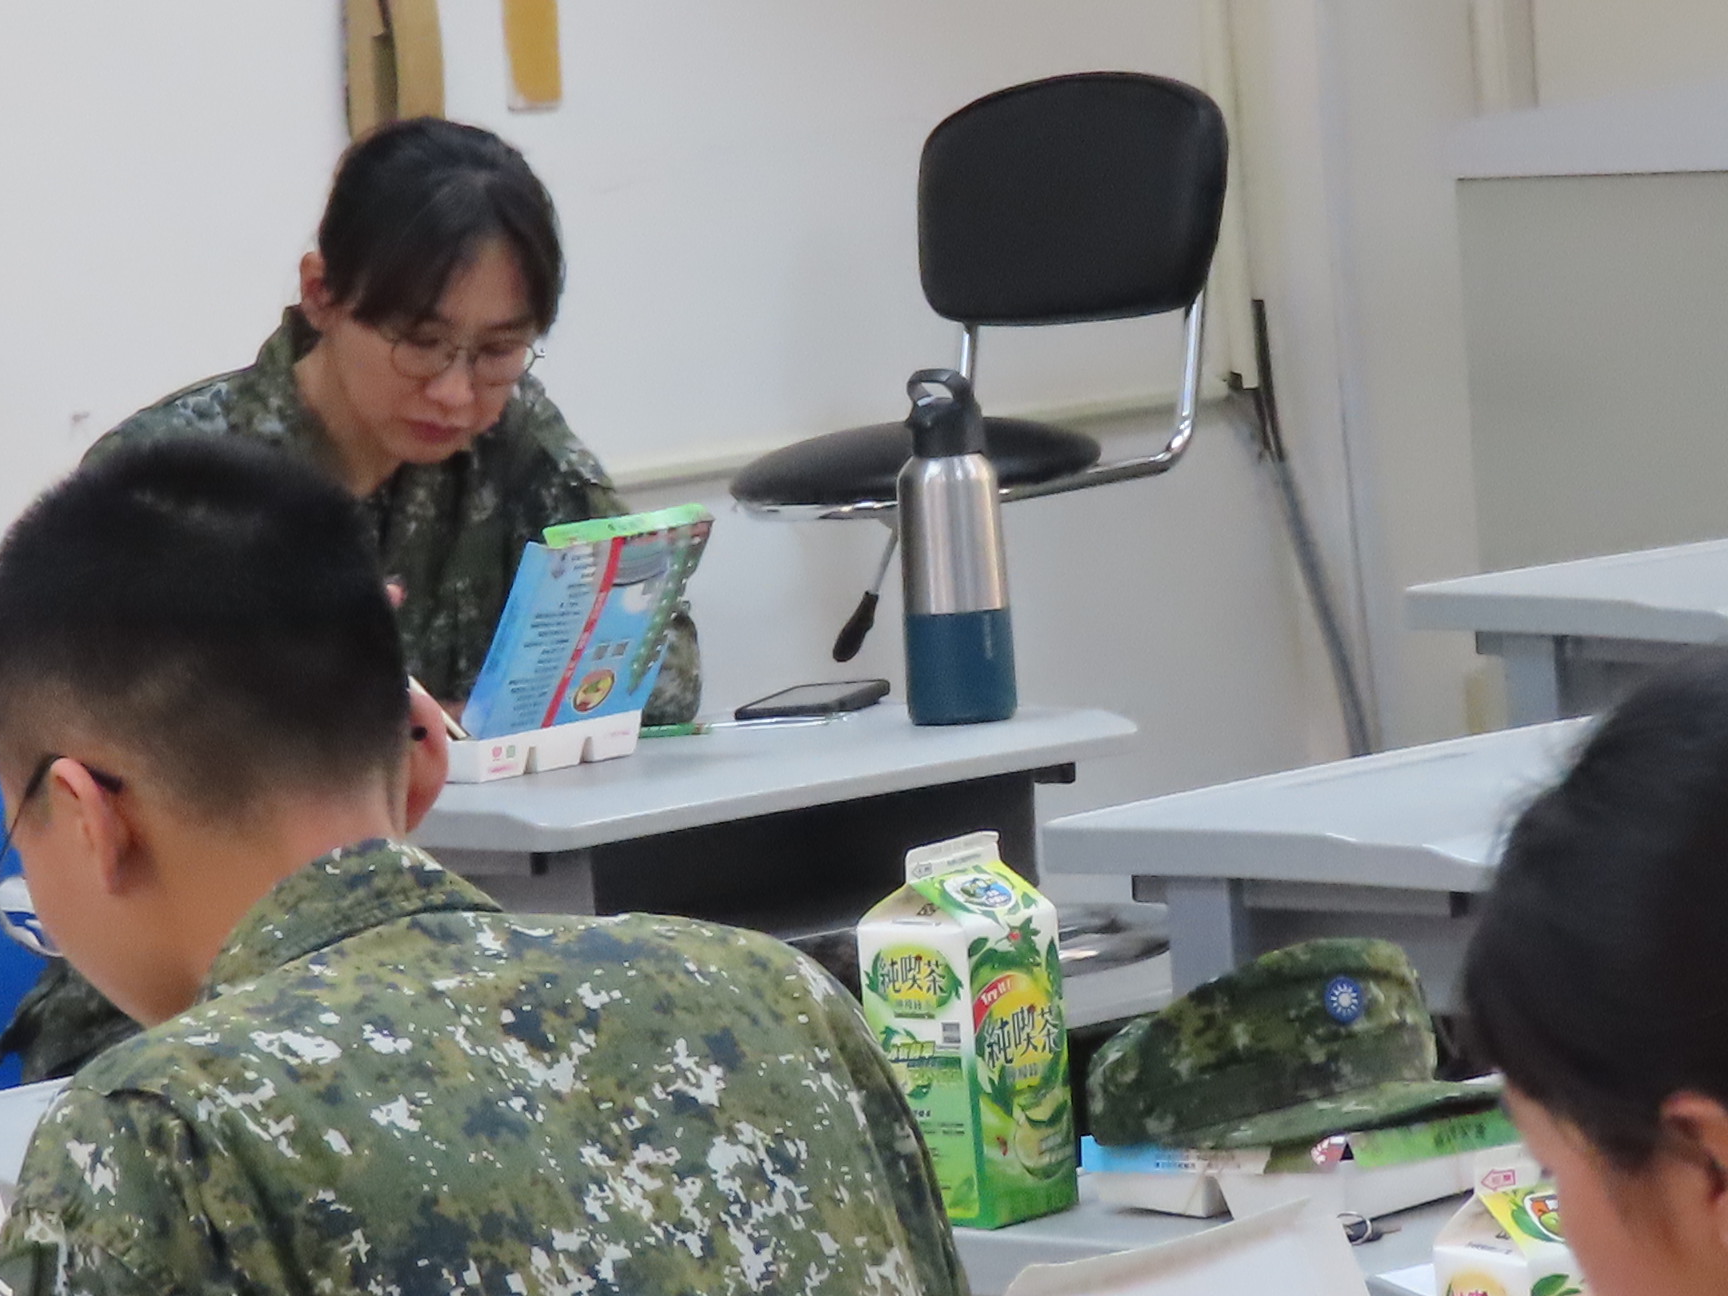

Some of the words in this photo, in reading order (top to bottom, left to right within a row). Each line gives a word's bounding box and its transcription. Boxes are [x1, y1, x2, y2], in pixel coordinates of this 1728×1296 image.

[877, 954, 947, 997] 純喫茶
[983, 1003, 1062, 1070] 純喫茶
